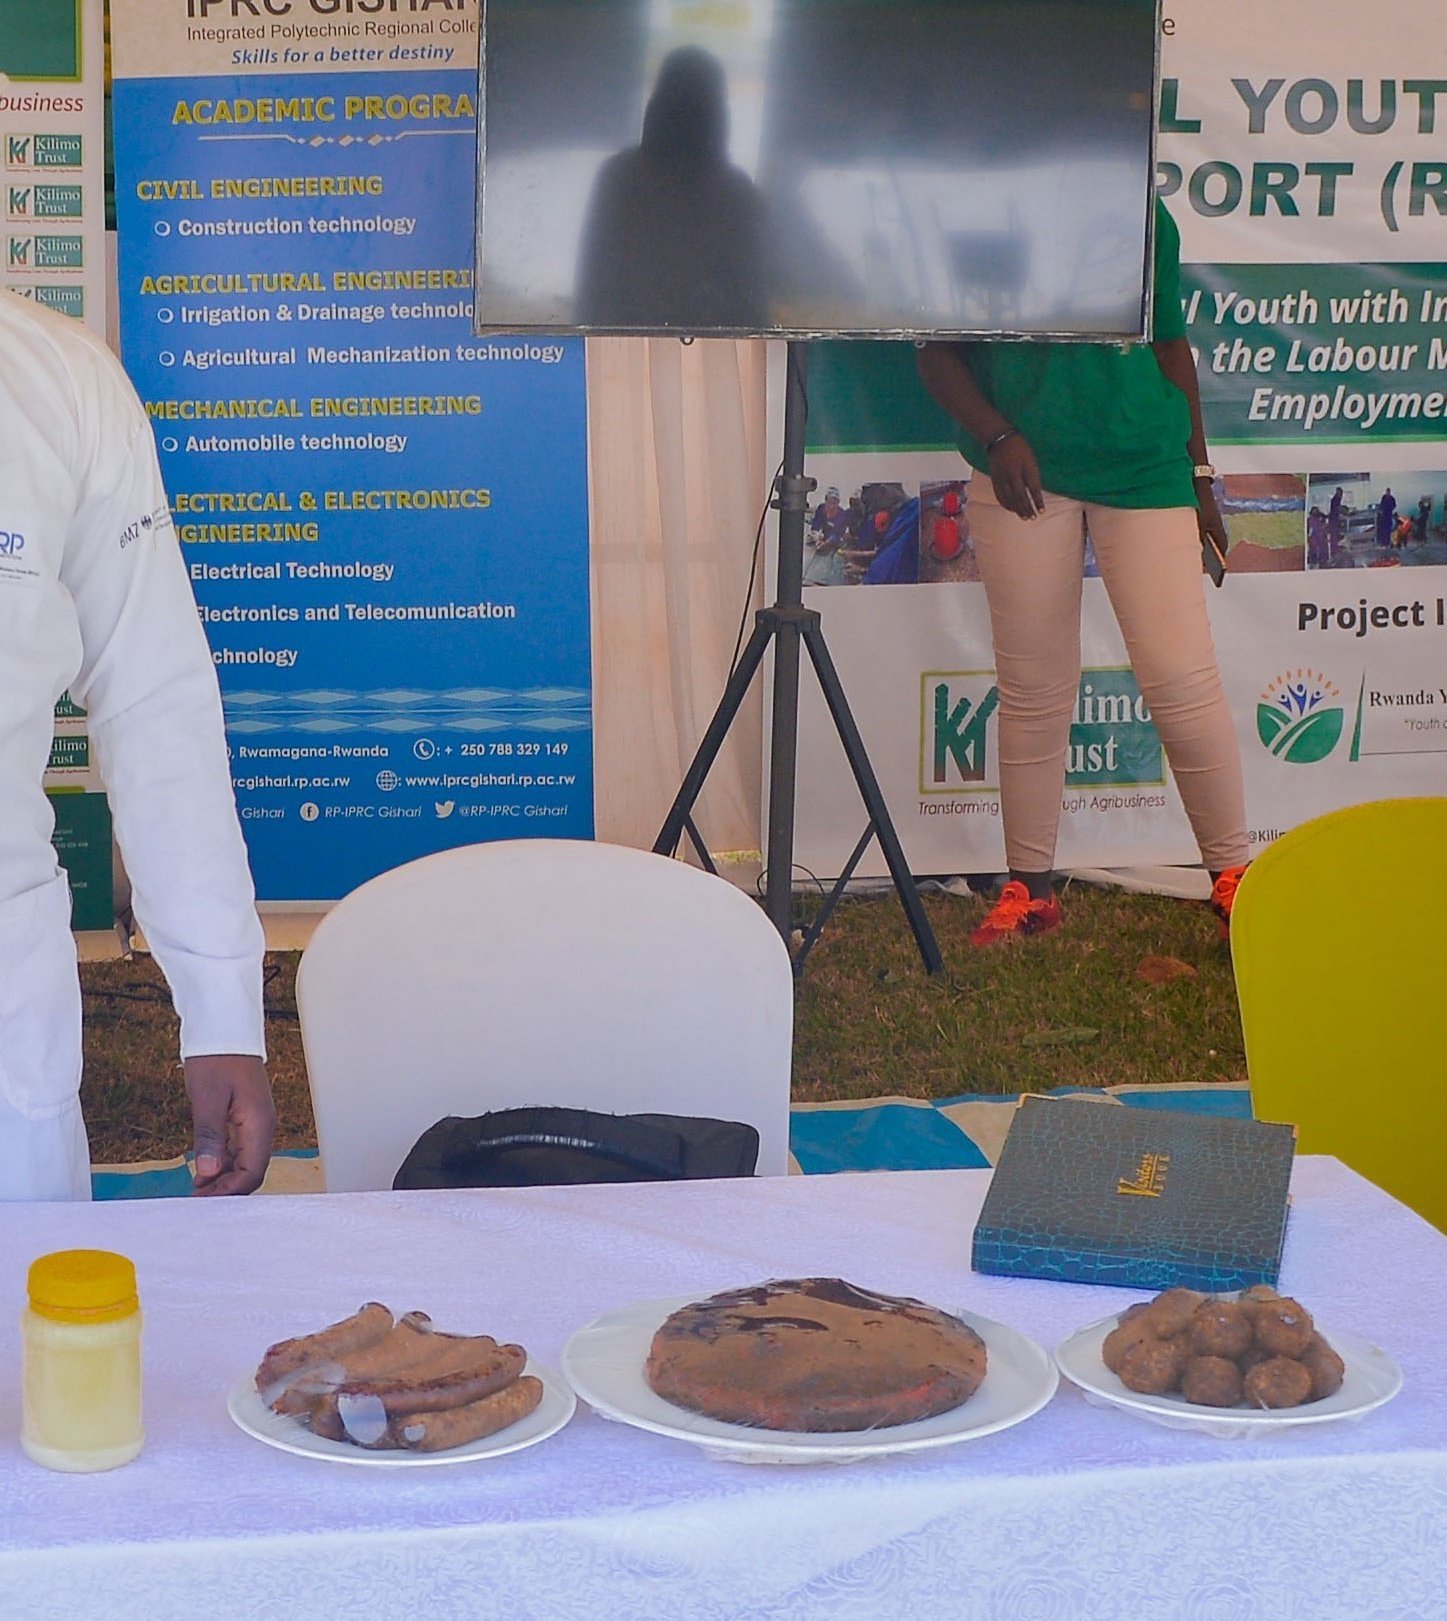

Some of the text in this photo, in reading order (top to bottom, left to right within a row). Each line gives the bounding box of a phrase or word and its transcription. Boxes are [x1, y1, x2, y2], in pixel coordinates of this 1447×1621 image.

[187, 25, 265, 43] Integrated
[271, 22, 360, 40] Polytechnic
[365, 19, 433, 38] Regional
[232, 44, 454, 64] Skills for a better destiny
[172, 94, 474, 125] ACADEMIC PROGRA
[1231, 78, 1447, 135] YOUT
[35, 137, 80, 151] Kilimo
[35, 151, 66, 163] Trust
[36, 188, 80, 201] Kilimo
[136, 175, 383, 201] CIVIL ENGINEERING
[36, 202, 67, 214] Trust
[178, 215, 416, 236] Construction technology
[36, 238, 81, 252] Kilimo
[36, 252, 67, 265] Trust
[140, 270, 475, 295] AGRICULTURAL ENGINEERI
[36, 288, 81, 302] Kilimo
[181, 306, 270, 327] Irrigation
[276, 305, 292, 321] &
[297, 303, 385, 323] Drainage
[1213, 290, 1318, 325] Youth
[1330, 289, 1408, 325] with
[182, 343, 564, 370] Agricultural Mechanization technology
[1211, 337, 1276, 373] the
[1286, 337, 1417, 373] Labour
[144, 395, 482, 420] MECHANICAL ENGINEERING
[1248, 385, 1447, 430] Employme
[185, 433, 407, 452] Automobile technology
[299, 492, 317, 510] &
[324, 488, 491, 510] ELECTRONICS
[190, 561, 394, 582] Electrical Technology
[305, 604, 340, 621] and
[345, 602, 516, 621] Telecomunication
[1298, 599, 1425, 637] Project
[1370, 690, 1433, 707] Rwanda
[239, 745, 389, 760] Rwamagana-Rwanda
[460, 744, 485, 756] 250
[489, 743, 513, 756] 788
[516, 743, 540, 756] 329
[545, 743, 568, 755] 149
[405, 774, 576, 788] www.iprcgishari.rp.ac.rw
[241, 807, 285, 819] Gishari
[325, 806, 375, 818] RP-IPRC
[378, 806, 422, 818] Gishari
[459, 804, 568, 817] @RP-IPRC Gishari
[918, 800, 999, 816] Transforming
[1092, 793, 1165, 809] Agribusiness
